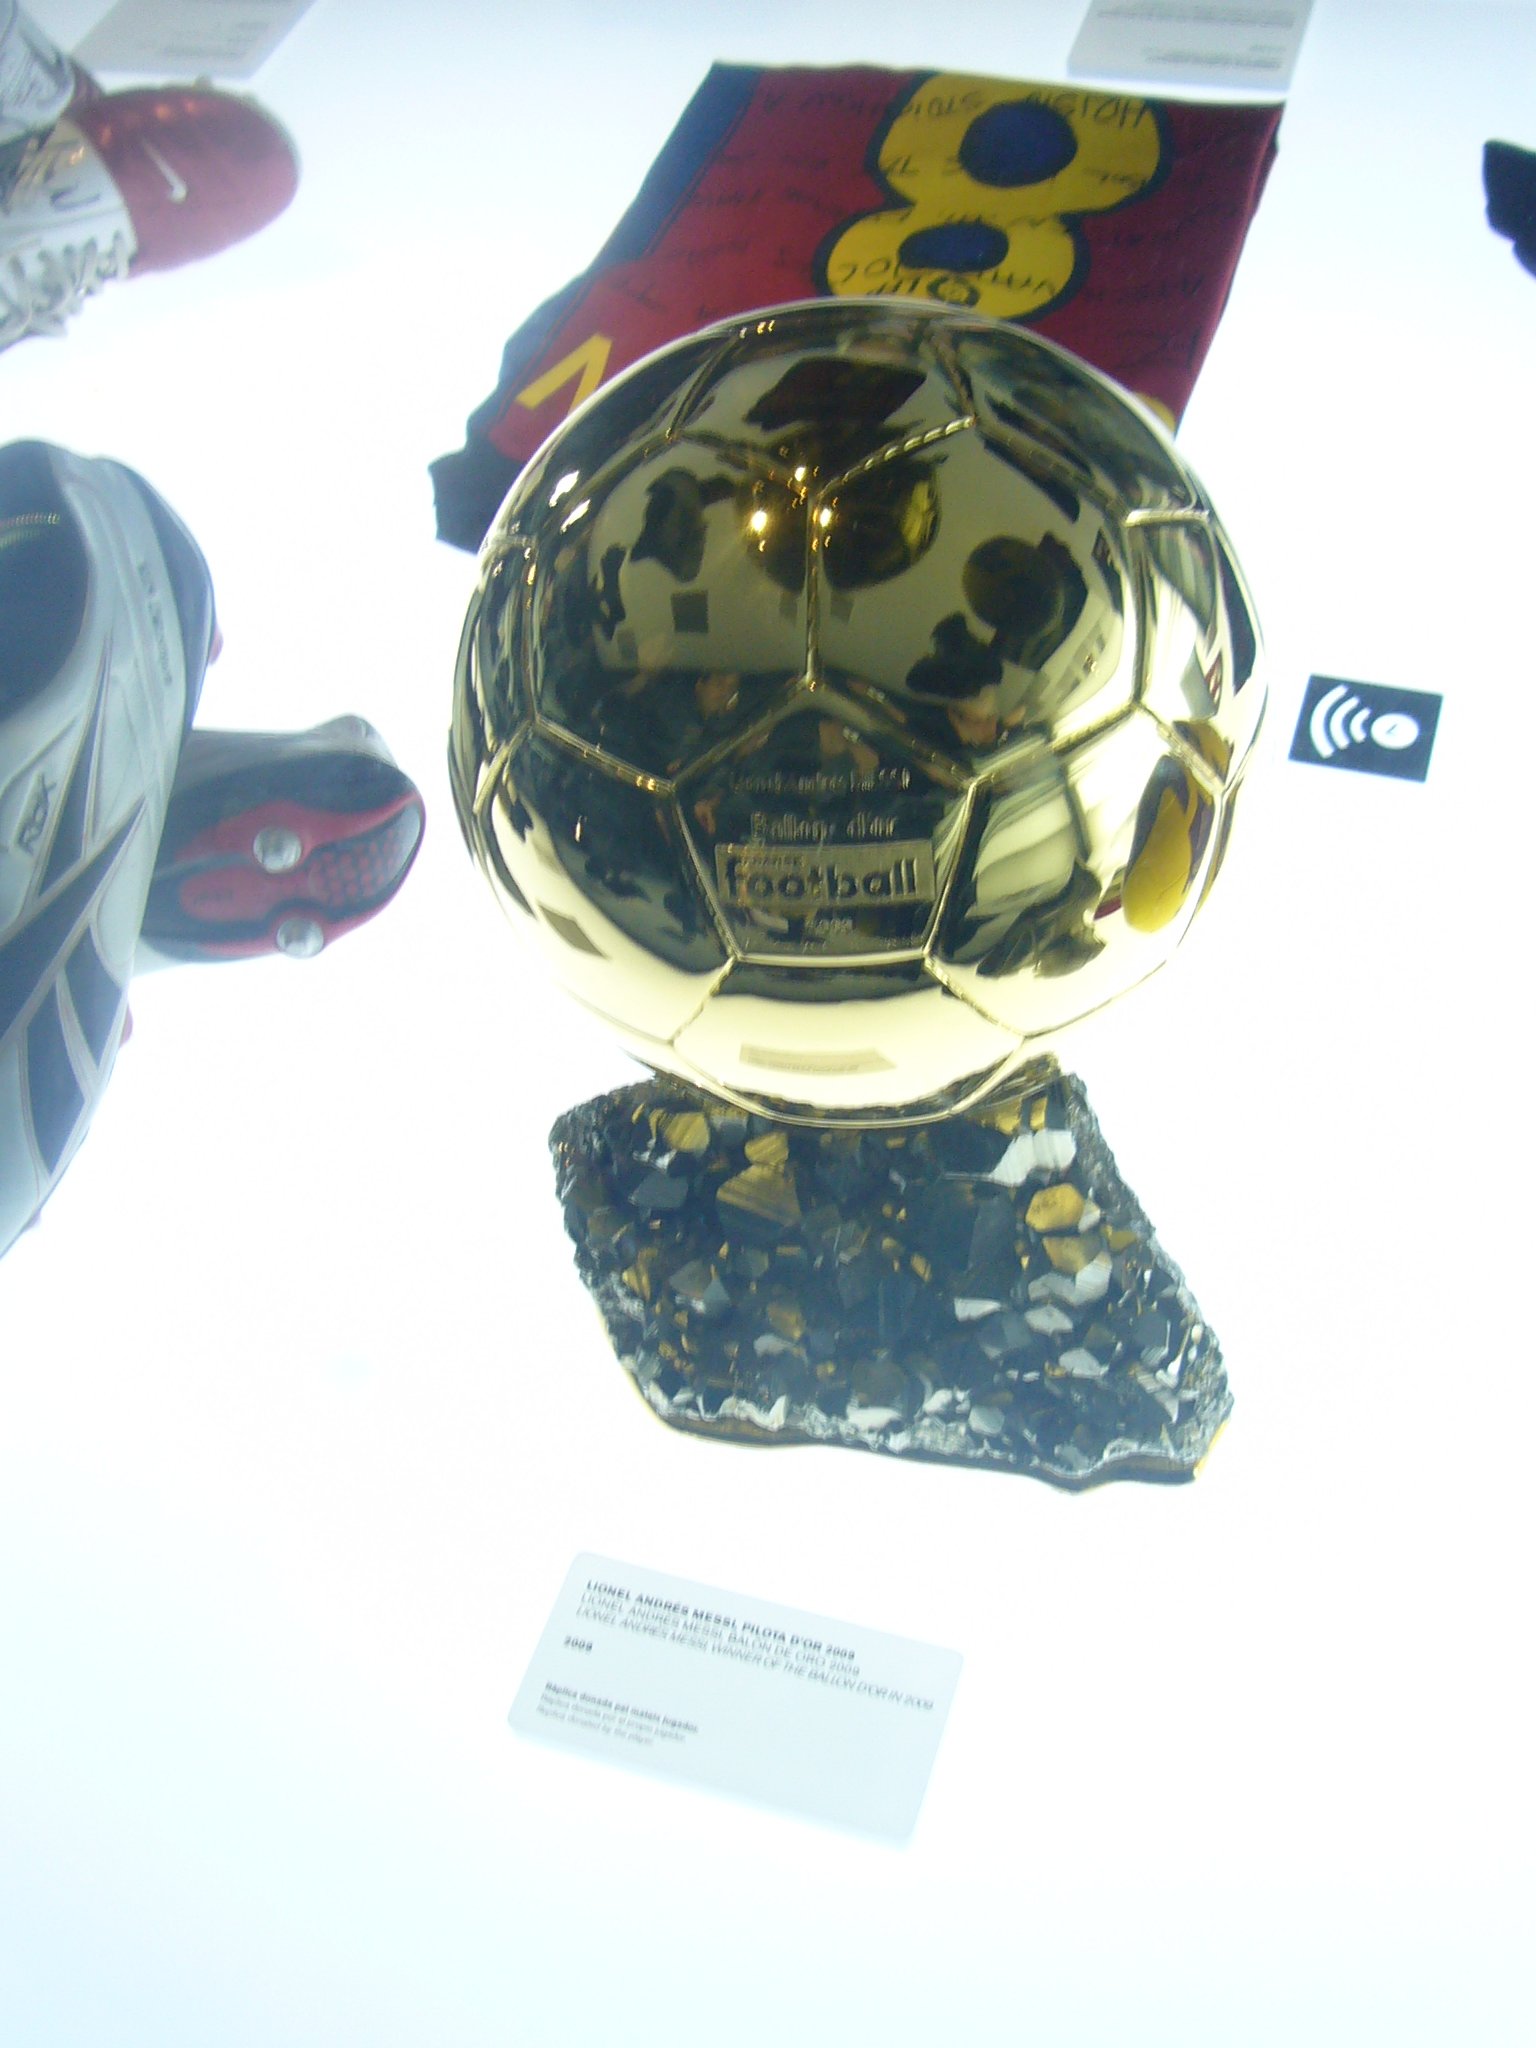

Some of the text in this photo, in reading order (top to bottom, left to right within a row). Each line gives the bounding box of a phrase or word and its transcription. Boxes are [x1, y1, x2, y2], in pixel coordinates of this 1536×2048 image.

[815, 70, 1170, 319] 8
[726, 857, 918, 898] football
[564, 1635, 593, 1652] 2009
[576, 1605, 615, 1625] LIONEL
[711, 1641, 763, 1665] WINNER
[580, 1593, 624, 1613] LIONEL
[774, 1645, 793, 1659] DE
[795, 1651, 825, 1668] ORO
[829, 1660, 860, 1677] 2009
[587, 1580, 632, 1601] LIONEL
[742, 1622, 786, 1642] PILOTA
[790, 1635, 822, 1652] D'OR
[826, 1644, 855, 1661] 2009
